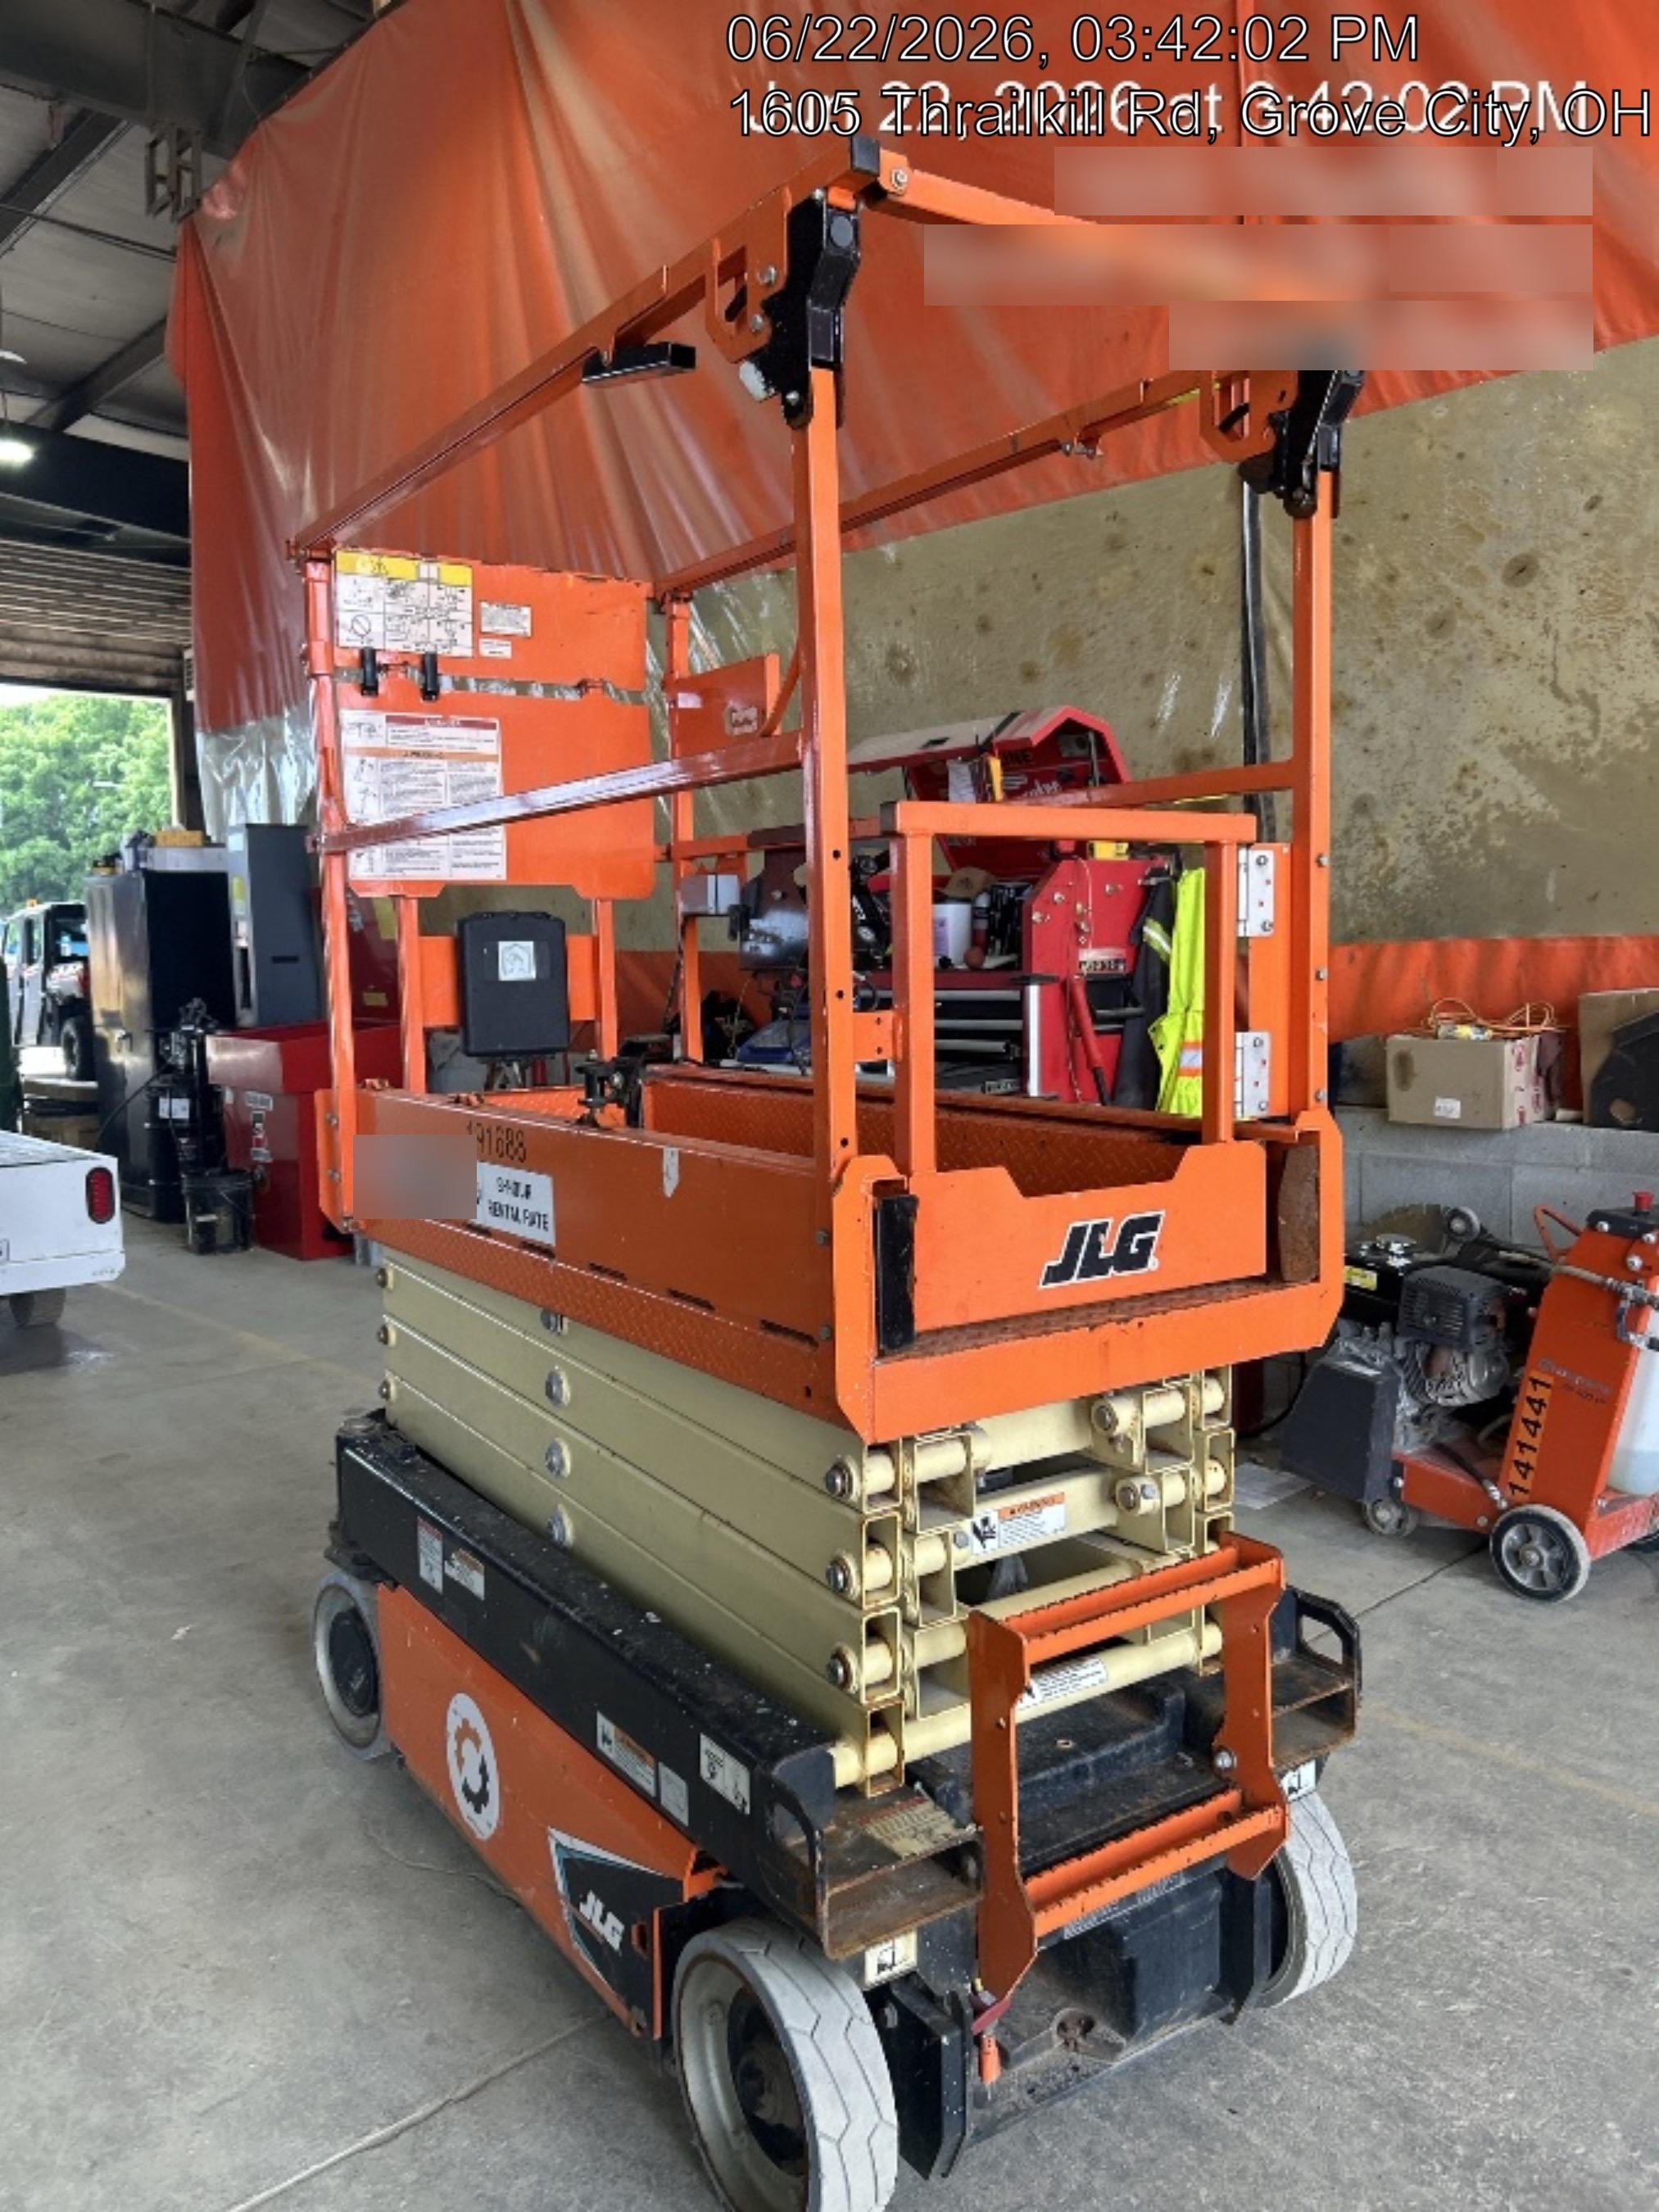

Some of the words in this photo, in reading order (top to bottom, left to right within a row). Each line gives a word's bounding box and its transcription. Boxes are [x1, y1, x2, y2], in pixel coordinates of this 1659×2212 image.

[1038, 1209, 1167, 1290] JLG
[1506, 1376, 1552, 1496] 141441
[578, 1889, 626, 1952] JLG
